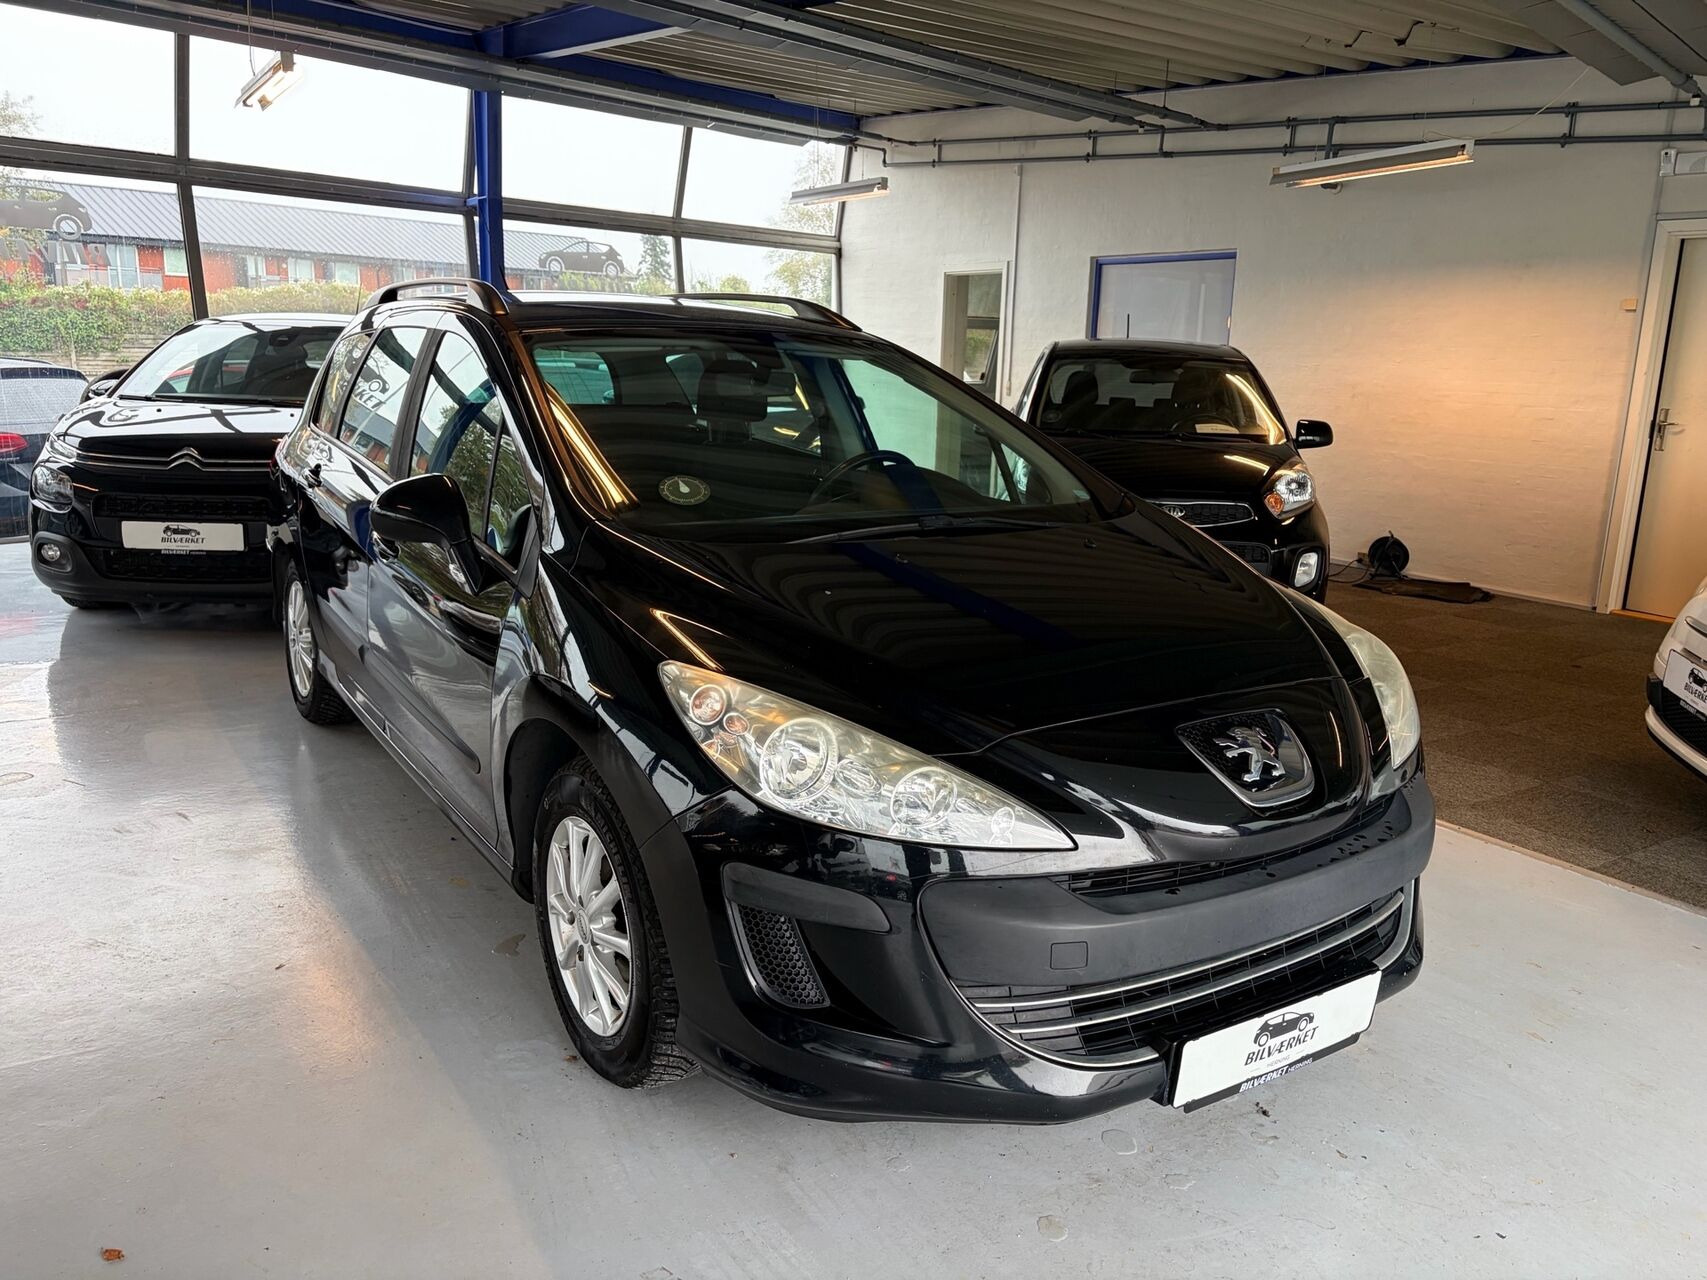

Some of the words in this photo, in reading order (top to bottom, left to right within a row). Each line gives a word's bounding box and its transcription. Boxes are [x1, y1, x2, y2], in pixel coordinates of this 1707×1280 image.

[1244, 1026, 1319, 1066] BILVÆRKET
[1239, 1065, 1289, 1093] BILVÆRKET
[1287, 1057, 1313, 1073] HERNING
